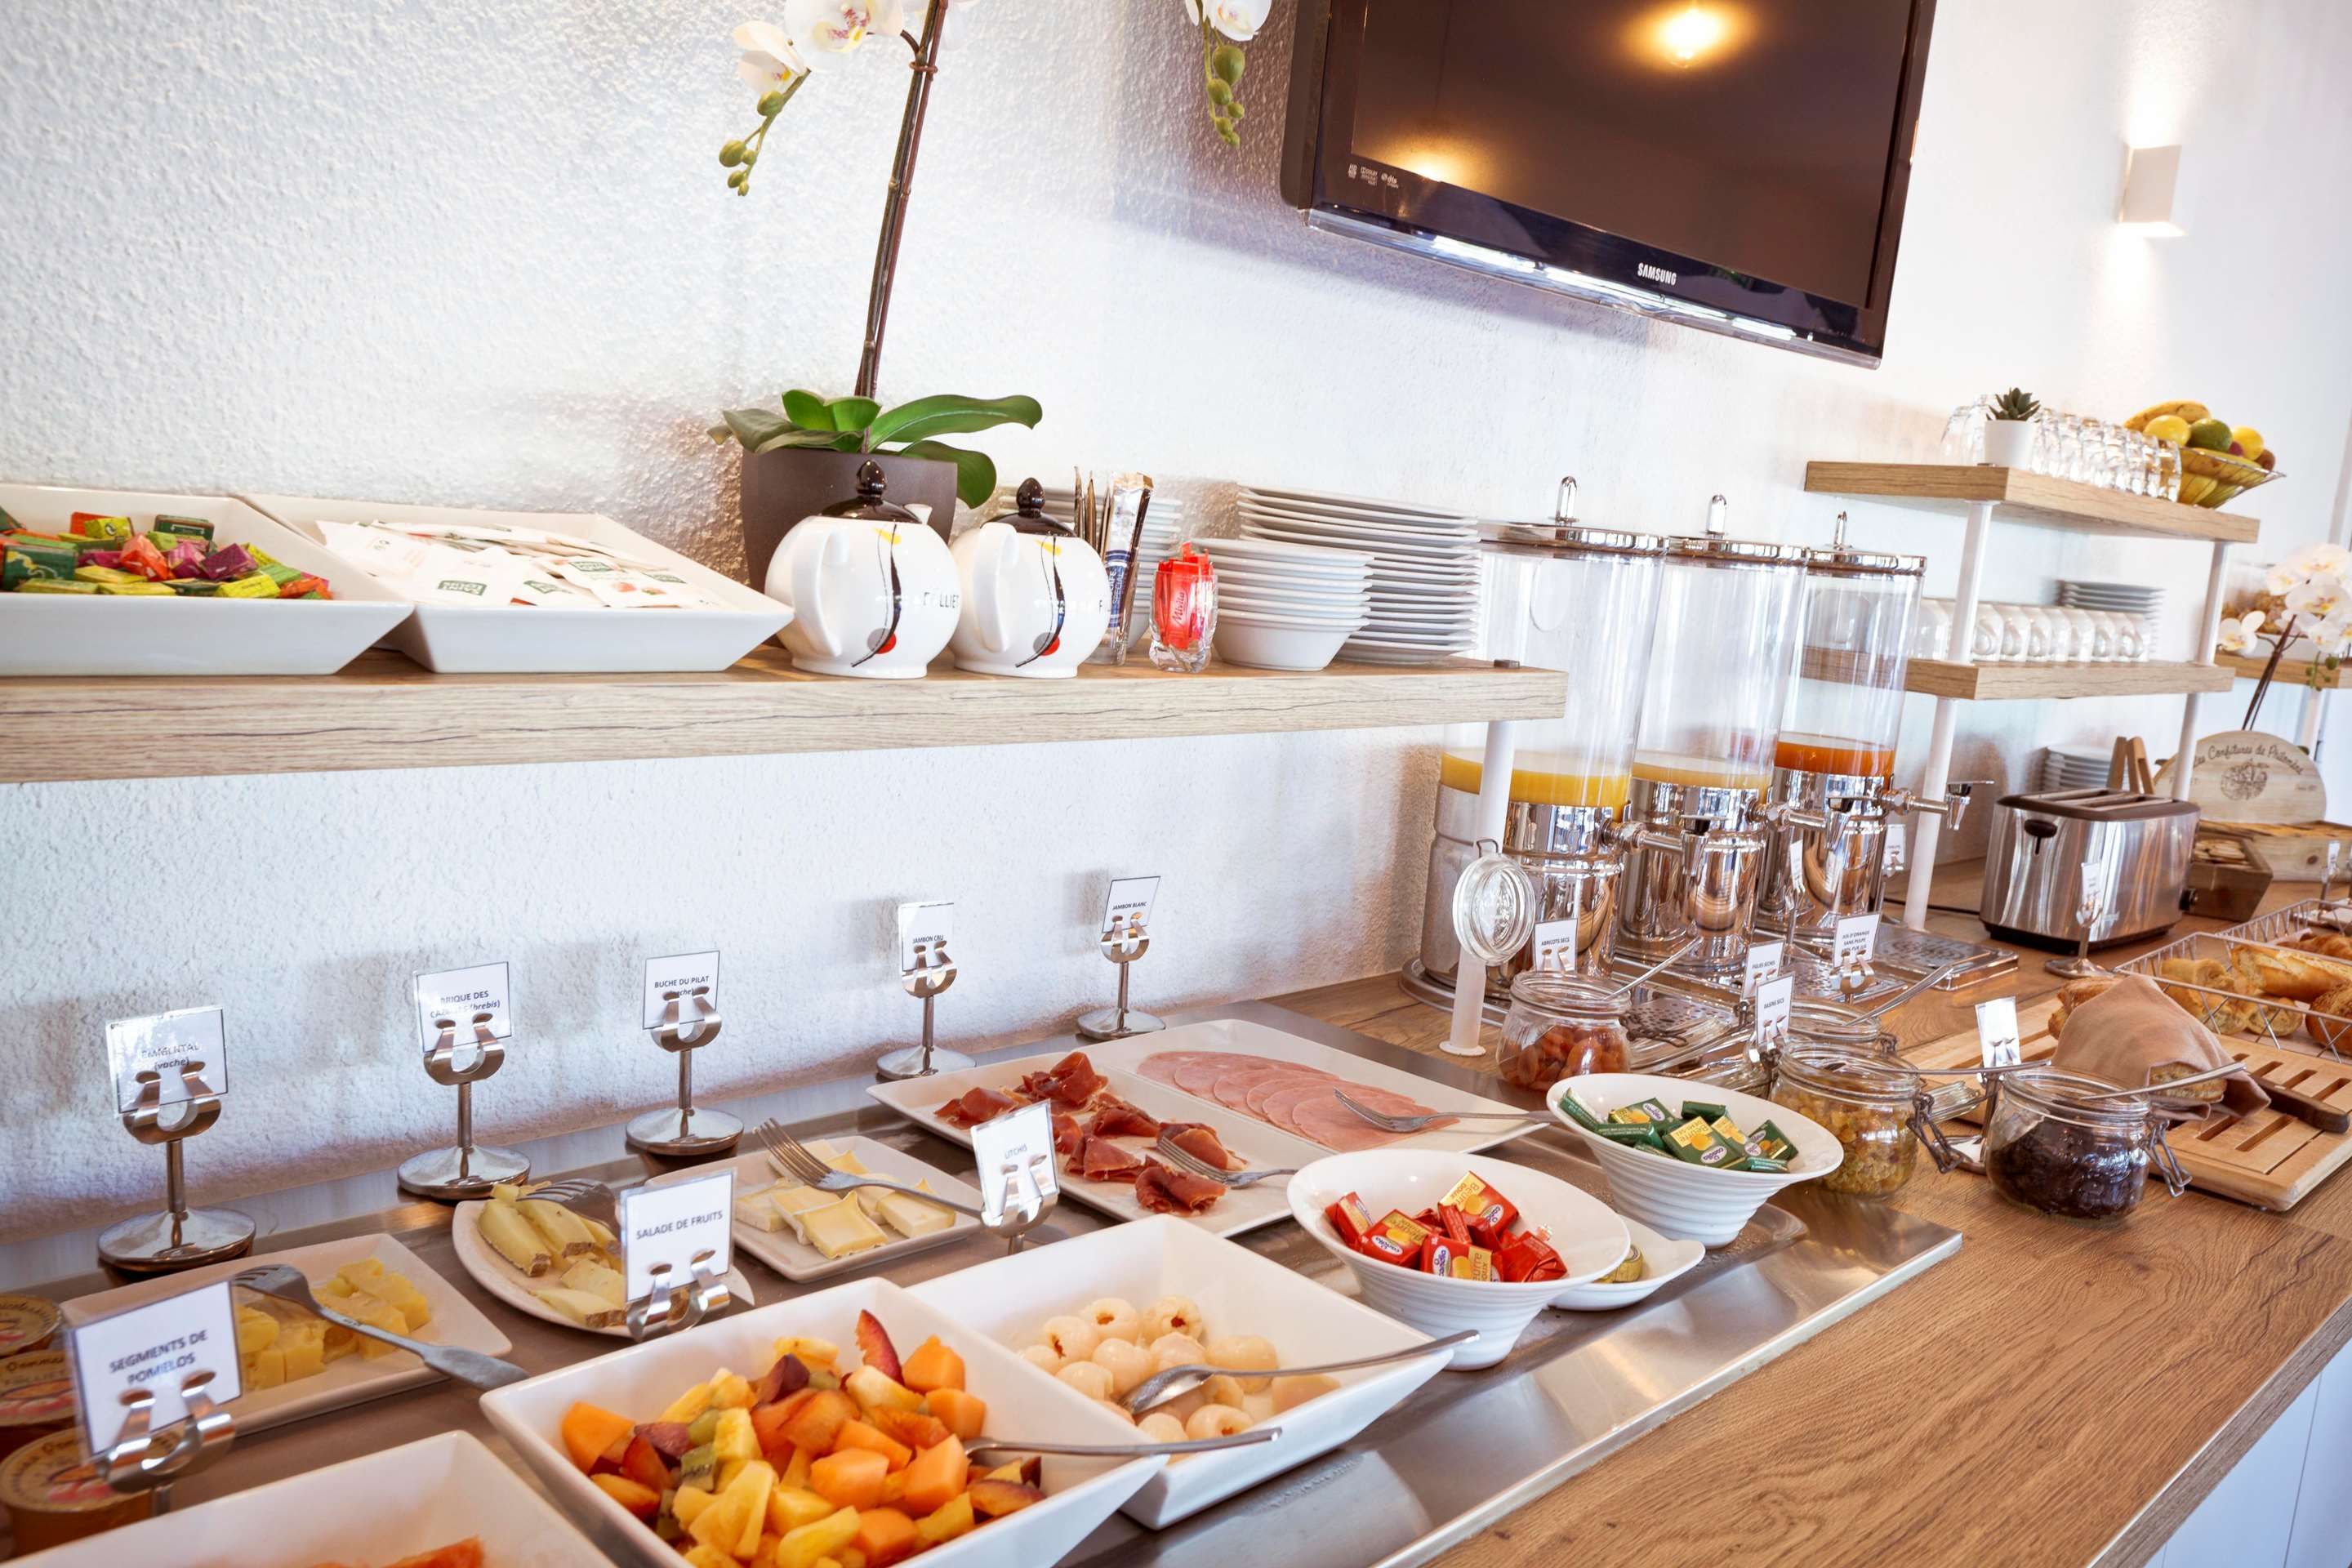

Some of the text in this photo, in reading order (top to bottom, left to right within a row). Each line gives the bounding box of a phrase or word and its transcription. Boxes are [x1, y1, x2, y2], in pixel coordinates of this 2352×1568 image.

[1637, 262, 1677, 286] SAMSUNG
[2255, 744, 2266, 755] de
[1111, 902, 1132, 911] JAMBON
[912, 935, 933, 944] JAMBON
[654, 975, 710, 988] BUCHE DU PILAT
[473, 990, 489, 1000] DES
[154, 1056, 190, 1071] (vache)
[636, 1209, 724, 1240] SALADE DE FRUITS
[1472, 1253, 1482, 1281] eurre
[109, 1330, 209, 1374] SEGMENTS DE
[127, 1352, 196, 1385] POMELOS
